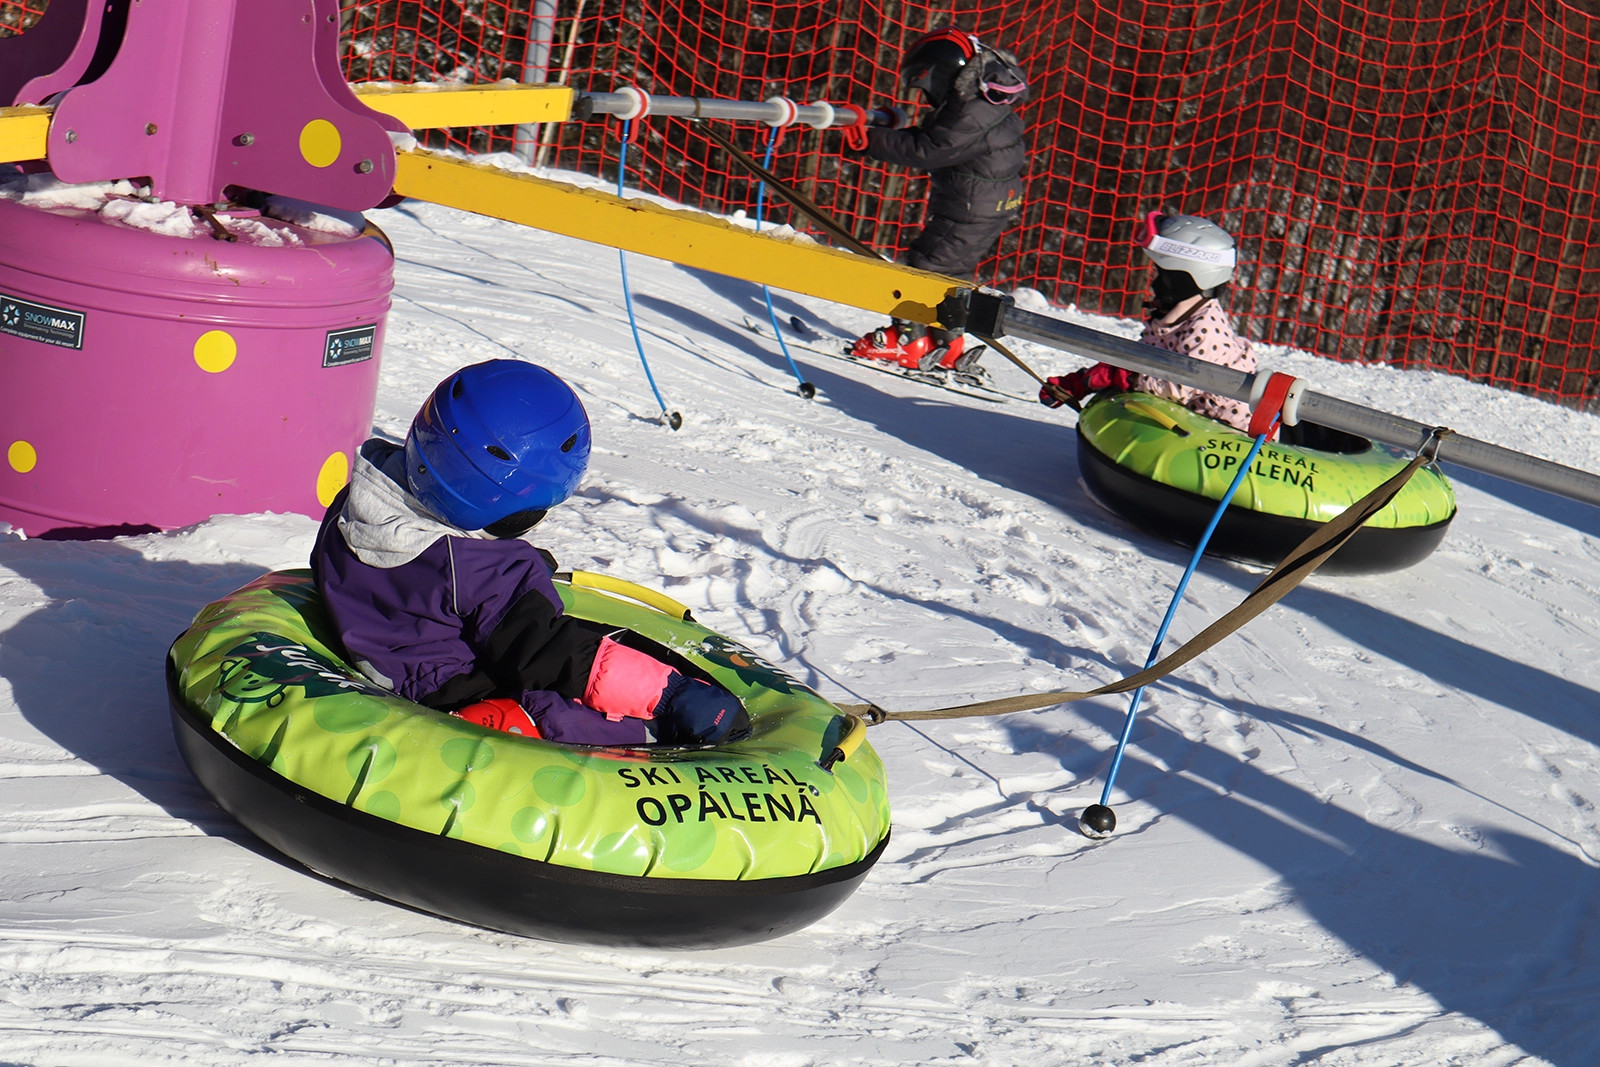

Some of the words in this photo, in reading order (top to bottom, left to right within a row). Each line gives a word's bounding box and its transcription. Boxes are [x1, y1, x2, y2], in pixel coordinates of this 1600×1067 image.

[24, 311, 76, 331] SNOWMAX
[1206, 439, 1241, 453] SKI
[1204, 453, 1315, 493] OPLENÁ
[617, 766, 681, 788] SKI
[694, 763, 808, 788] AREÁL
[636, 784, 823, 827] OPÁLENÁ
